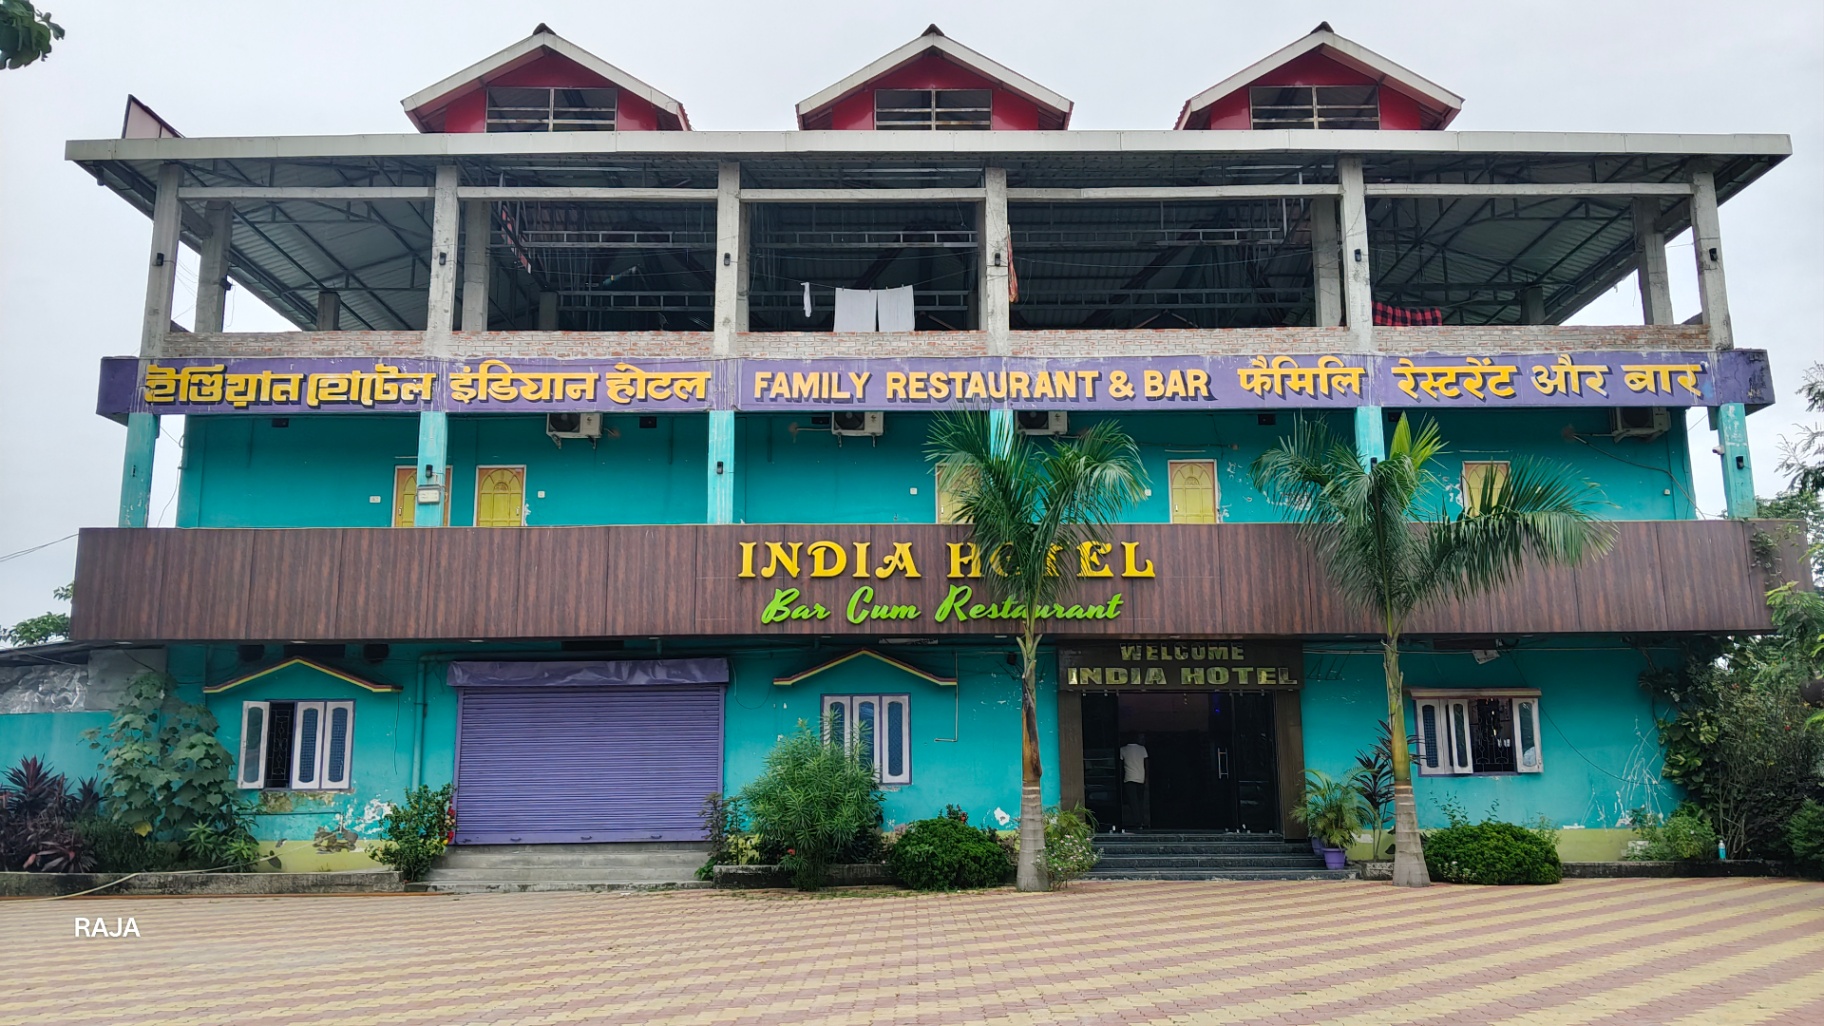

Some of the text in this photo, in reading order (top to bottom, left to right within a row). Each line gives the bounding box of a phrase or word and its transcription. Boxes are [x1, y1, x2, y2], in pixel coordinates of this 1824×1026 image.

[307, 363, 437, 406] হোটেল
[449, 359, 712, 404] इंडियान होटल
[754, 369, 1210, 400] FAMILY RESTAURANT & BAR
[1237, 354, 1703, 399] फैमिलि रेस्टरेंट और बार
[737, 541, 921, 578] INDIA
[760, 584, 1124, 625] Bar Cum Restaurant
[1120, 643, 1244, 661] WELCOME
[1067, 667, 1298, 685] INDIA HOTEL
